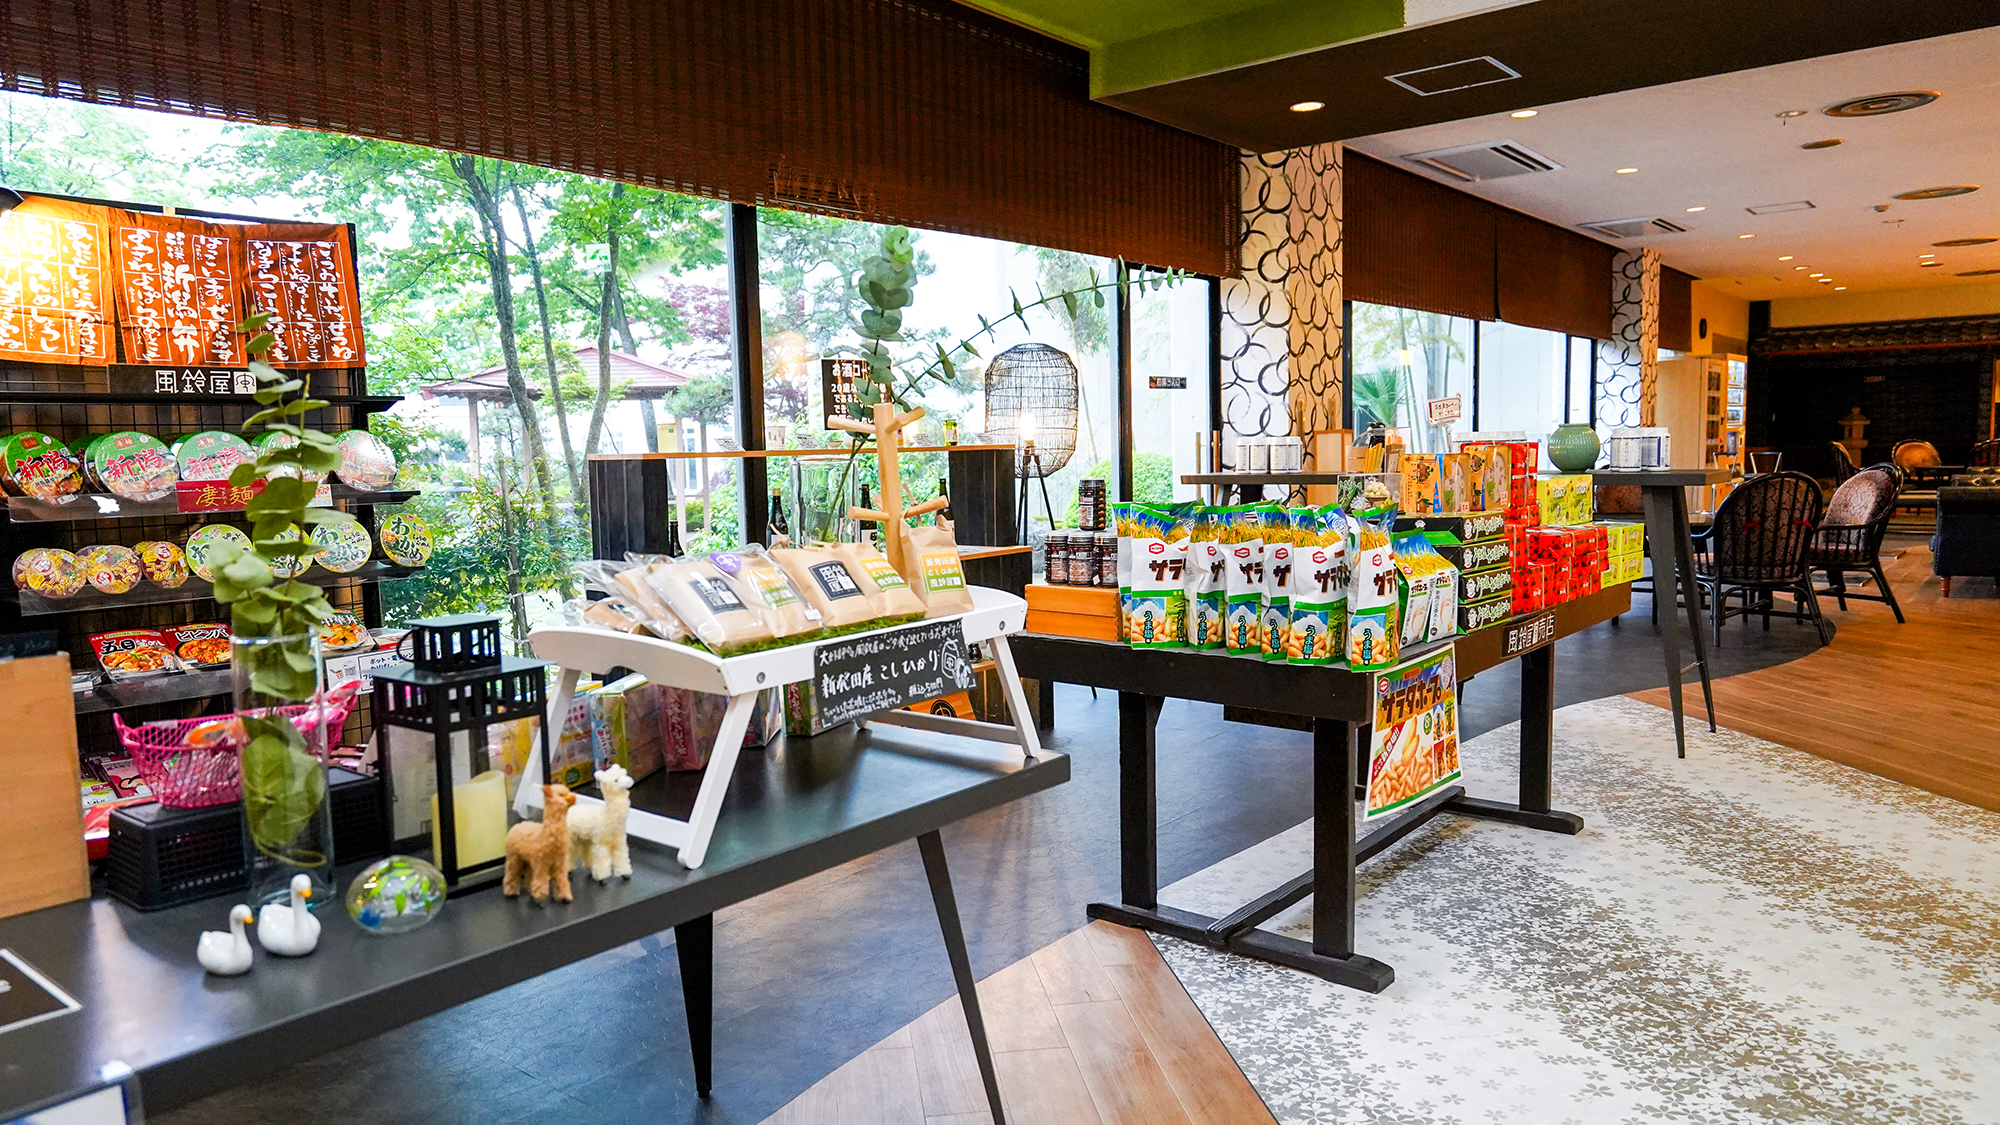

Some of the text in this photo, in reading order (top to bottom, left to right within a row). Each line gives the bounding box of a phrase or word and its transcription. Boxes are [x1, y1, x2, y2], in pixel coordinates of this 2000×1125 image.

[161, 260, 203, 363] 新潟弁
[154, 370, 231, 394] 風鈴屋
[832, 362, 870, 377] お酒コー
[15, 449, 69, 482] 新潟
[105, 448, 165, 480] 新潟
[187, 446, 244, 477] 新潟
[391, 516, 424, 562] わかめ
[925, 556, 957, 566] 新発田産
[1149, 559, 1186, 581] サラ
[1303, 625, 1316, 654] うま塩
[880, 649, 938, 681] こしひかり
[1382, 674, 1442, 724] サラダホープ
